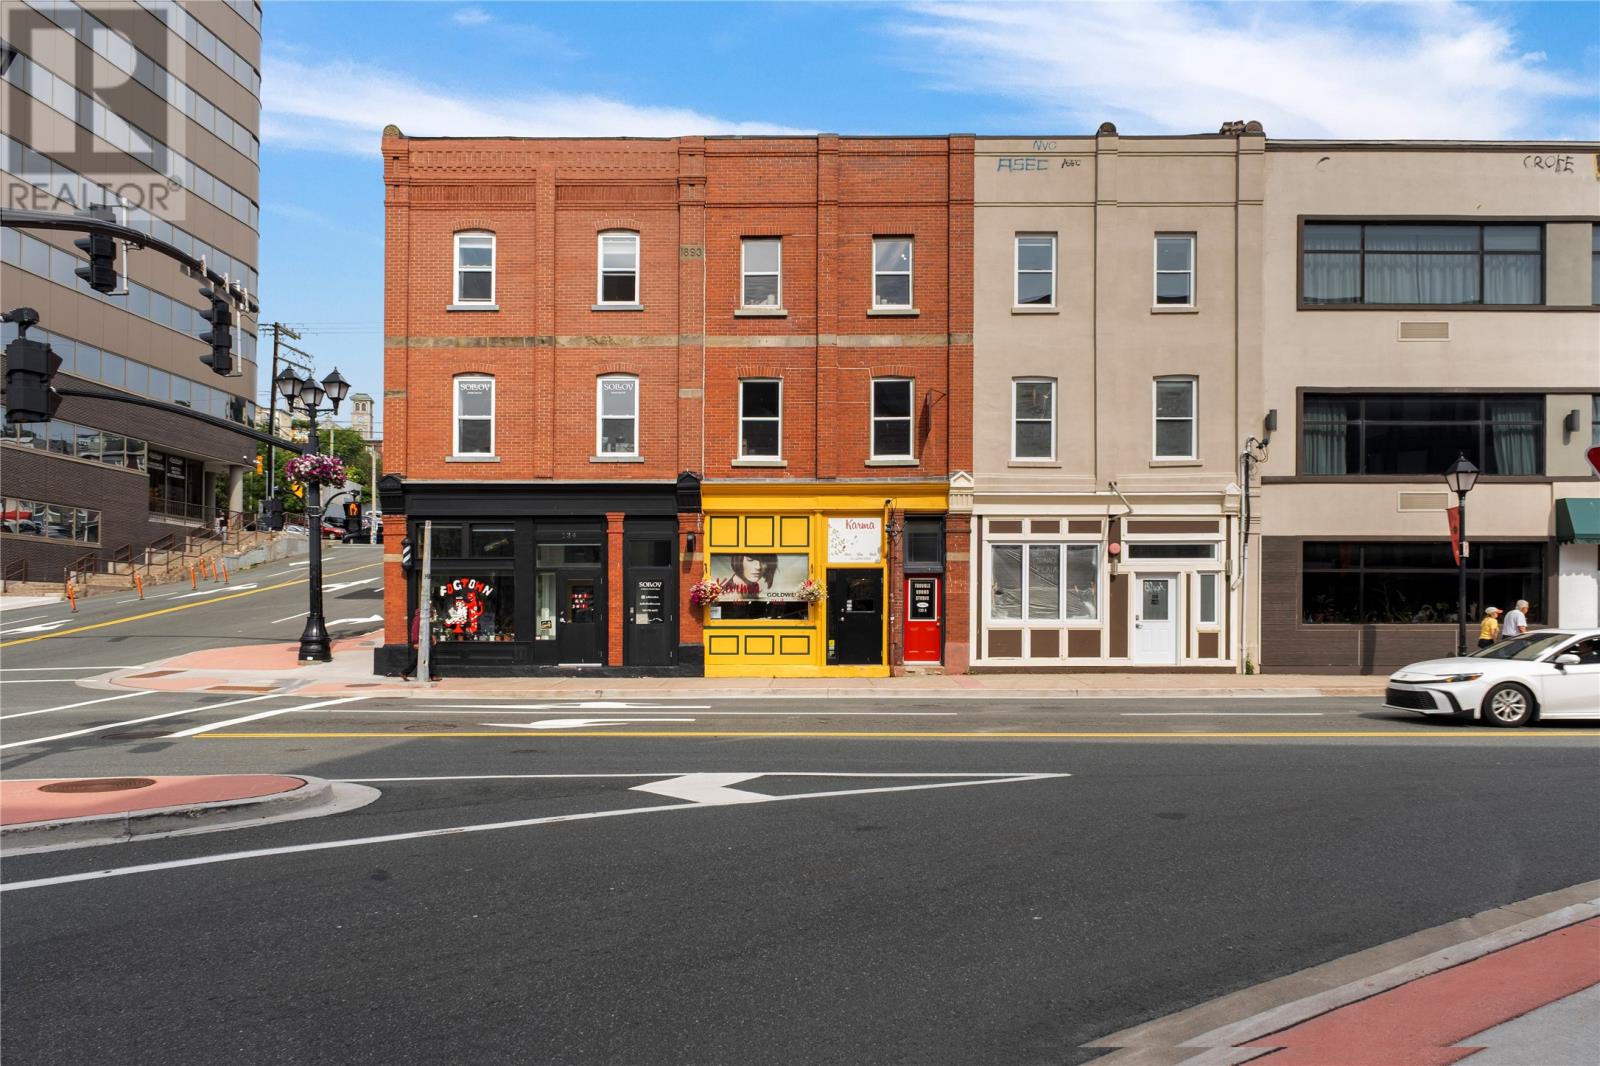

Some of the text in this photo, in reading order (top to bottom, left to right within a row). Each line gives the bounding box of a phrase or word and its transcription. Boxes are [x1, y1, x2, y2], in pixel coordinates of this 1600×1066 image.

[680, 247, 702, 257] 1893
[846, 519, 876, 530] Karma
[440, 577, 494, 596] FOGTOWN
